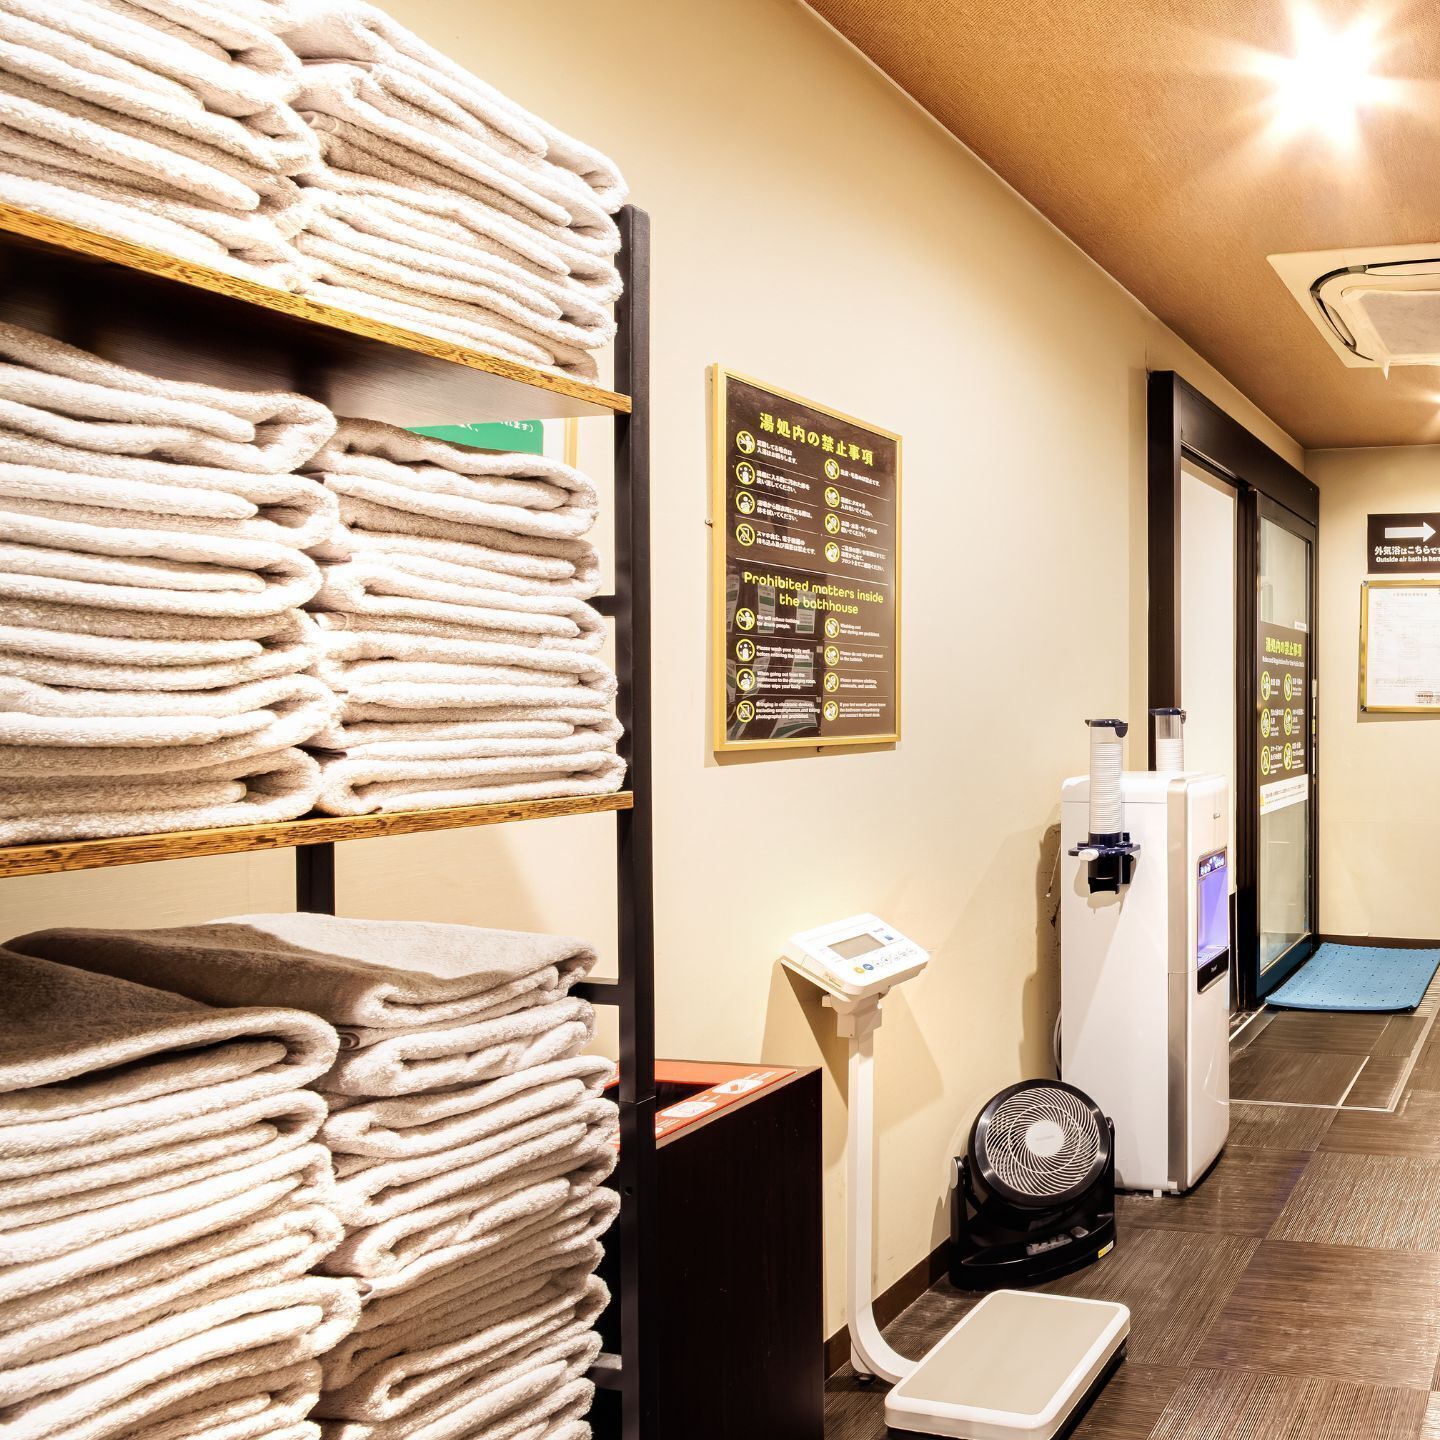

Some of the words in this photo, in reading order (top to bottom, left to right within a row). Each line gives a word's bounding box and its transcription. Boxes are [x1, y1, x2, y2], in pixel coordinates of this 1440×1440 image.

[759, 411, 874, 467] 湯処内の禁止事項
[743, 571, 809, 592] Prohibited
[811, 583, 855, 600] matters
[857, 590, 884, 604] inside
[779, 593, 800, 607] the
[802, 595, 859, 615] bathhouse
